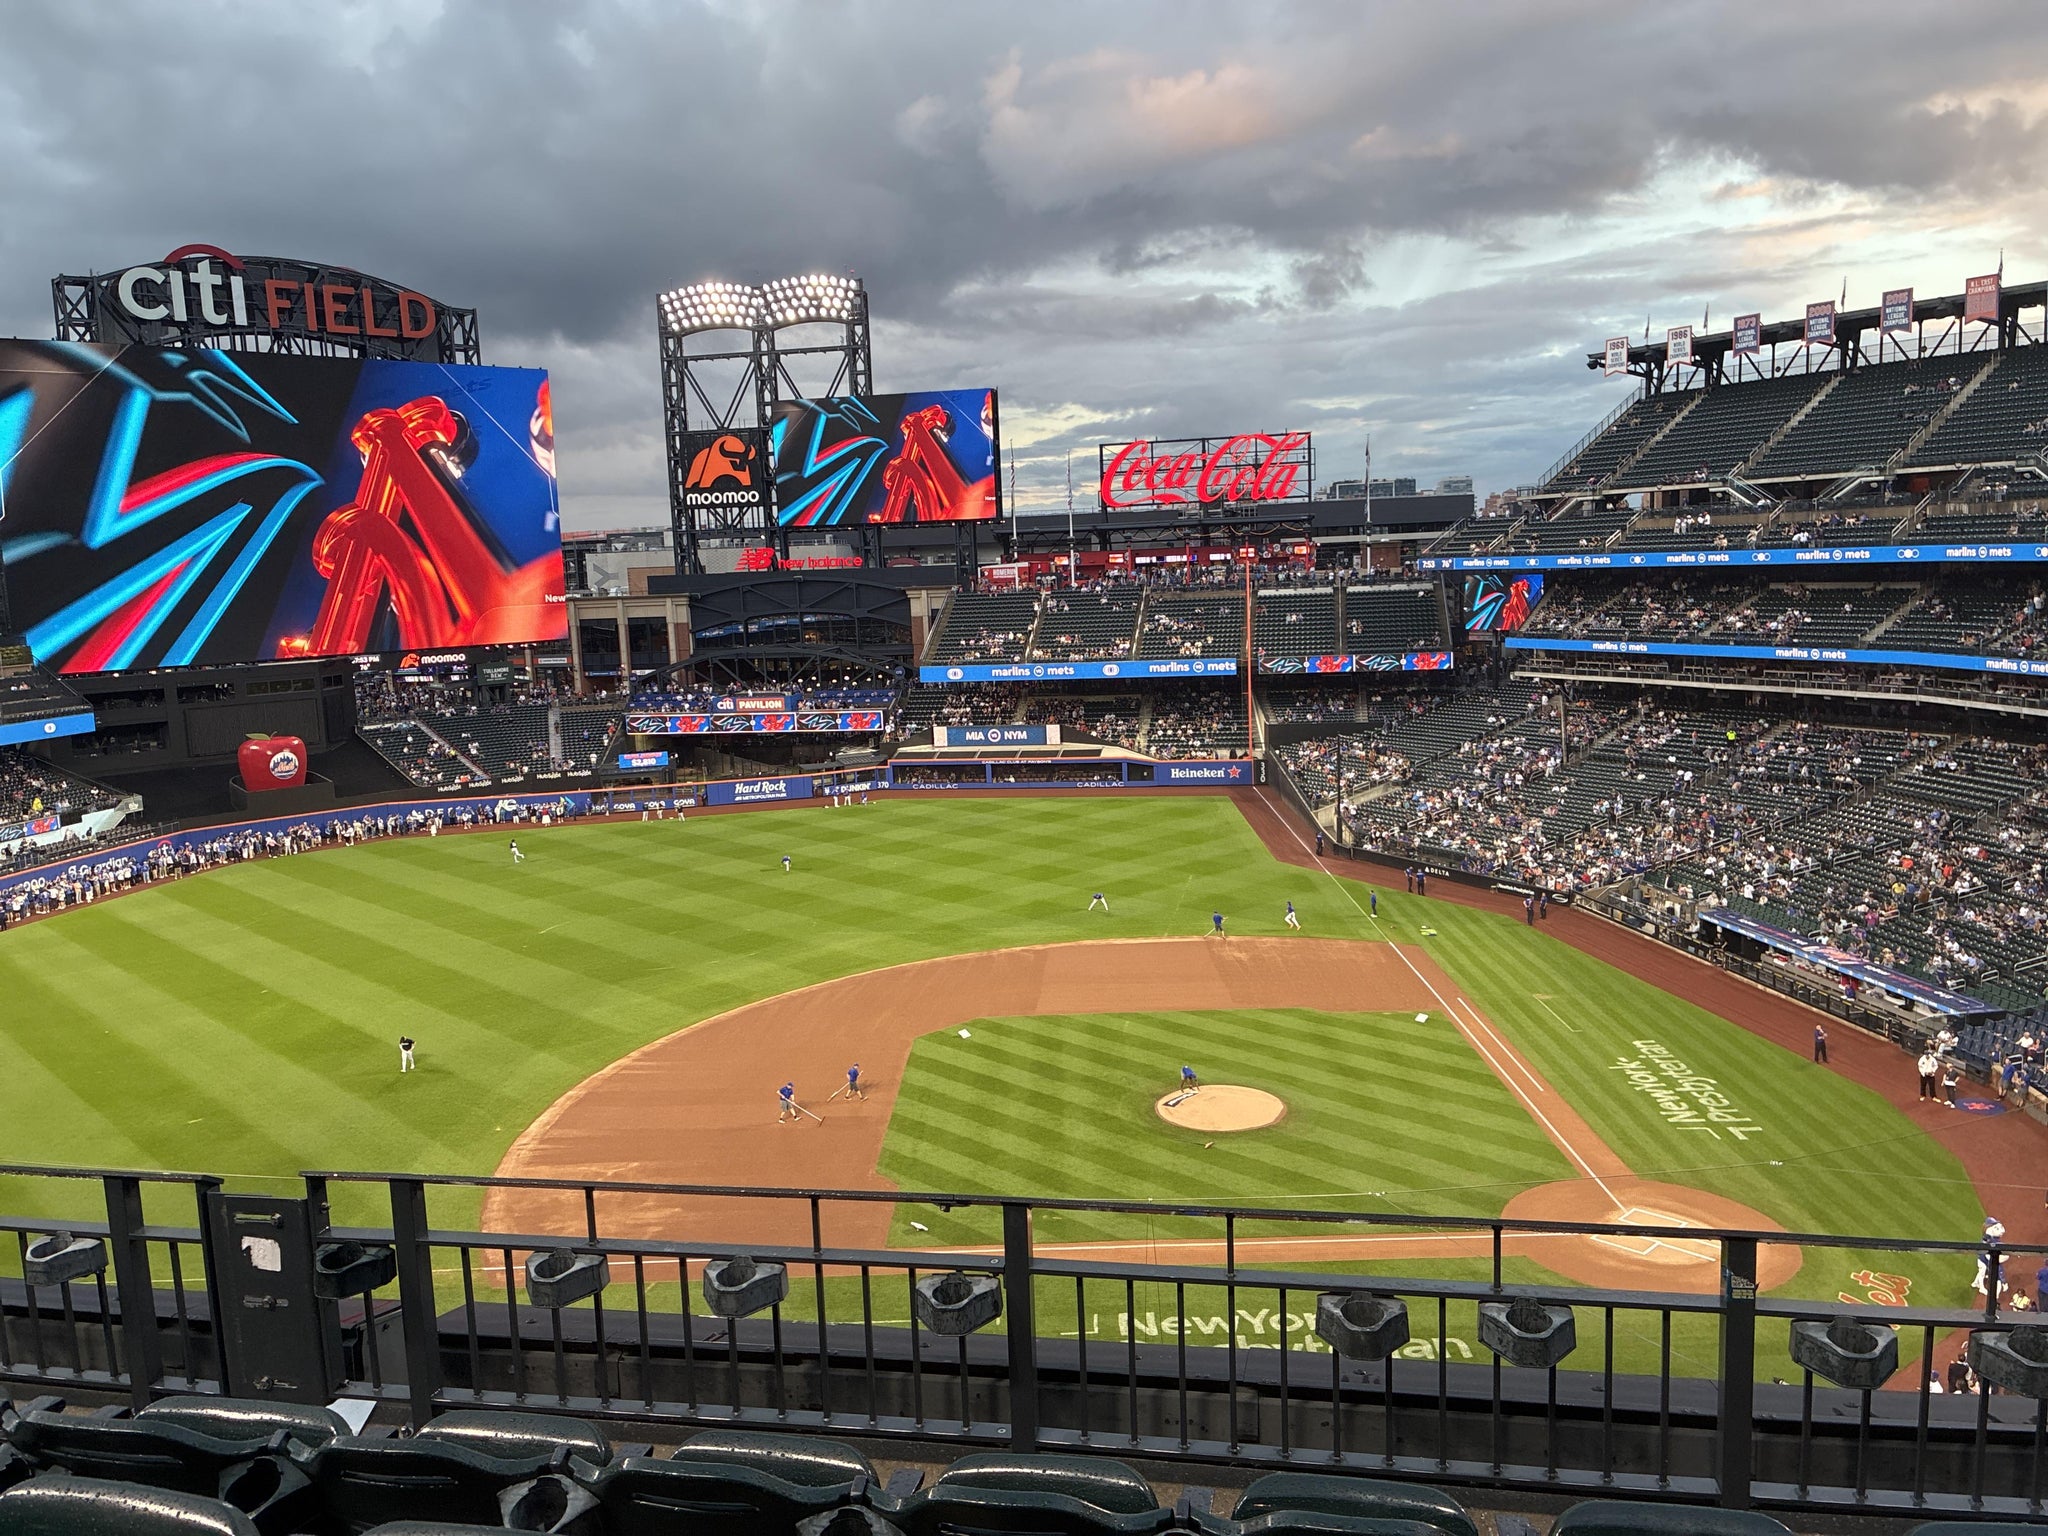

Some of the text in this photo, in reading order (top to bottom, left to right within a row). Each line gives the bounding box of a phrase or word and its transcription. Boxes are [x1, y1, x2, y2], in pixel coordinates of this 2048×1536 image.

[1968, 284, 1996, 295] CHAMPIONS
[264, 279, 437, 339] FIELD
[1885, 305, 1907, 314] NATIONAL
[1887, 312, 1905, 320] LEAGUE
[1883, 317, 1908, 327] CHAMPIONS
[1671, 330, 1688, 341] 1986
[1101, 431, 1311, 508] Coca-Cola
[686, 490, 760, 506] moomoo
[1666, 553, 1696, 563] marlins
[1707, 552, 1730, 563] mets
[1795, 549, 1830, 560] marlins
[1845, 549, 1871, 559] mets
[1946, 547, 1976, 558] marlins
[1988, 547, 2012, 557] mets
[777, 555, 863, 570] new balance
[1462, 558, 1485, 567] marlins
[1493, 558, 1509, 567] mets
[1557, 556, 1611, 566] marlins mets
[545, 594, 566, 603] New
[1592, 642, 1648, 652] marlins mets
[421, 653, 466, 664] moomoo
[1775, 648, 1808, 659] marlins
[1822, 650, 1847, 660] mets
[1149, 661, 1190, 673] marlins
[1207, 661, 1237, 671] mets
[1985, 659, 2018, 671] marlins
[992, 666, 1031, 677] marlins
[1047, 665, 1075, 676] mets
[739, 699, 783, 709] PAVILION
[965, 731, 985, 741] MIA
[1004, 730, 1028, 740] NYM
[1170, 767, 1225, 779] Heineken
[735, 779, 786, 794] Hard Rock
[877, 781, 889, 789] 370
[1430, 868, 1450, 877] DELTA
